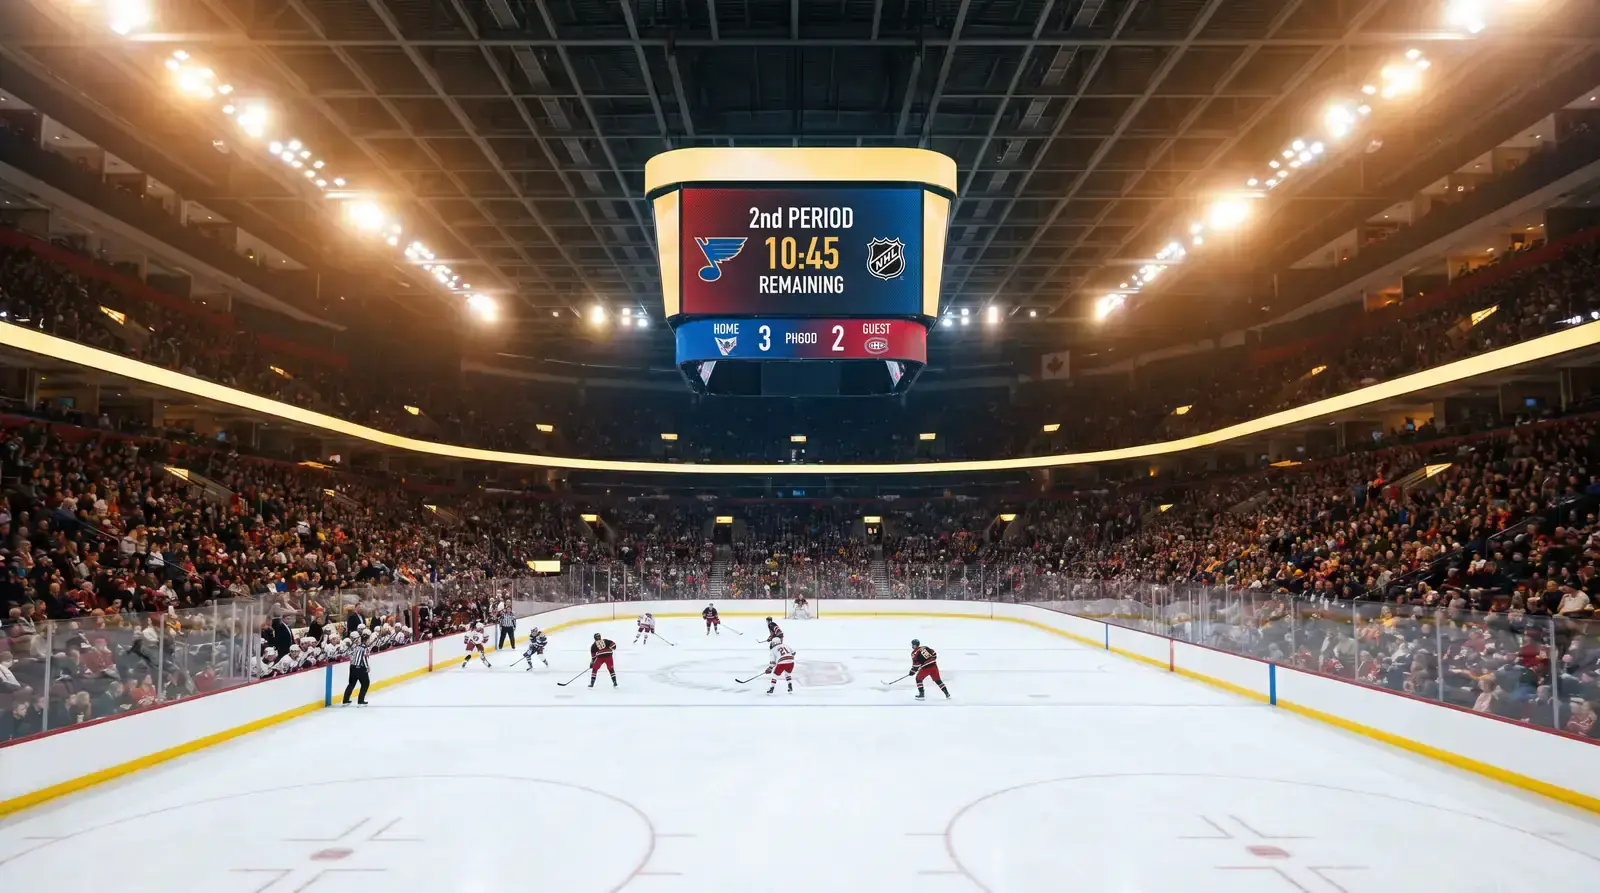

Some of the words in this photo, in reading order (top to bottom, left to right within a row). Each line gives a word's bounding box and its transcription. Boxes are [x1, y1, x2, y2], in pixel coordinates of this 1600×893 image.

[749, 208, 783, 229] 2nd
[788, 207, 853, 229] PERIOD
[765, 236, 839, 270] 10:45
[875, 248, 898, 270] NHL
[759, 276, 844, 294] REMAINING
[713, 323, 739, 334] HOME
[758, 325, 771, 351] 3
[831, 325, 845, 351] 2
[862, 323, 891, 334] GUEST
